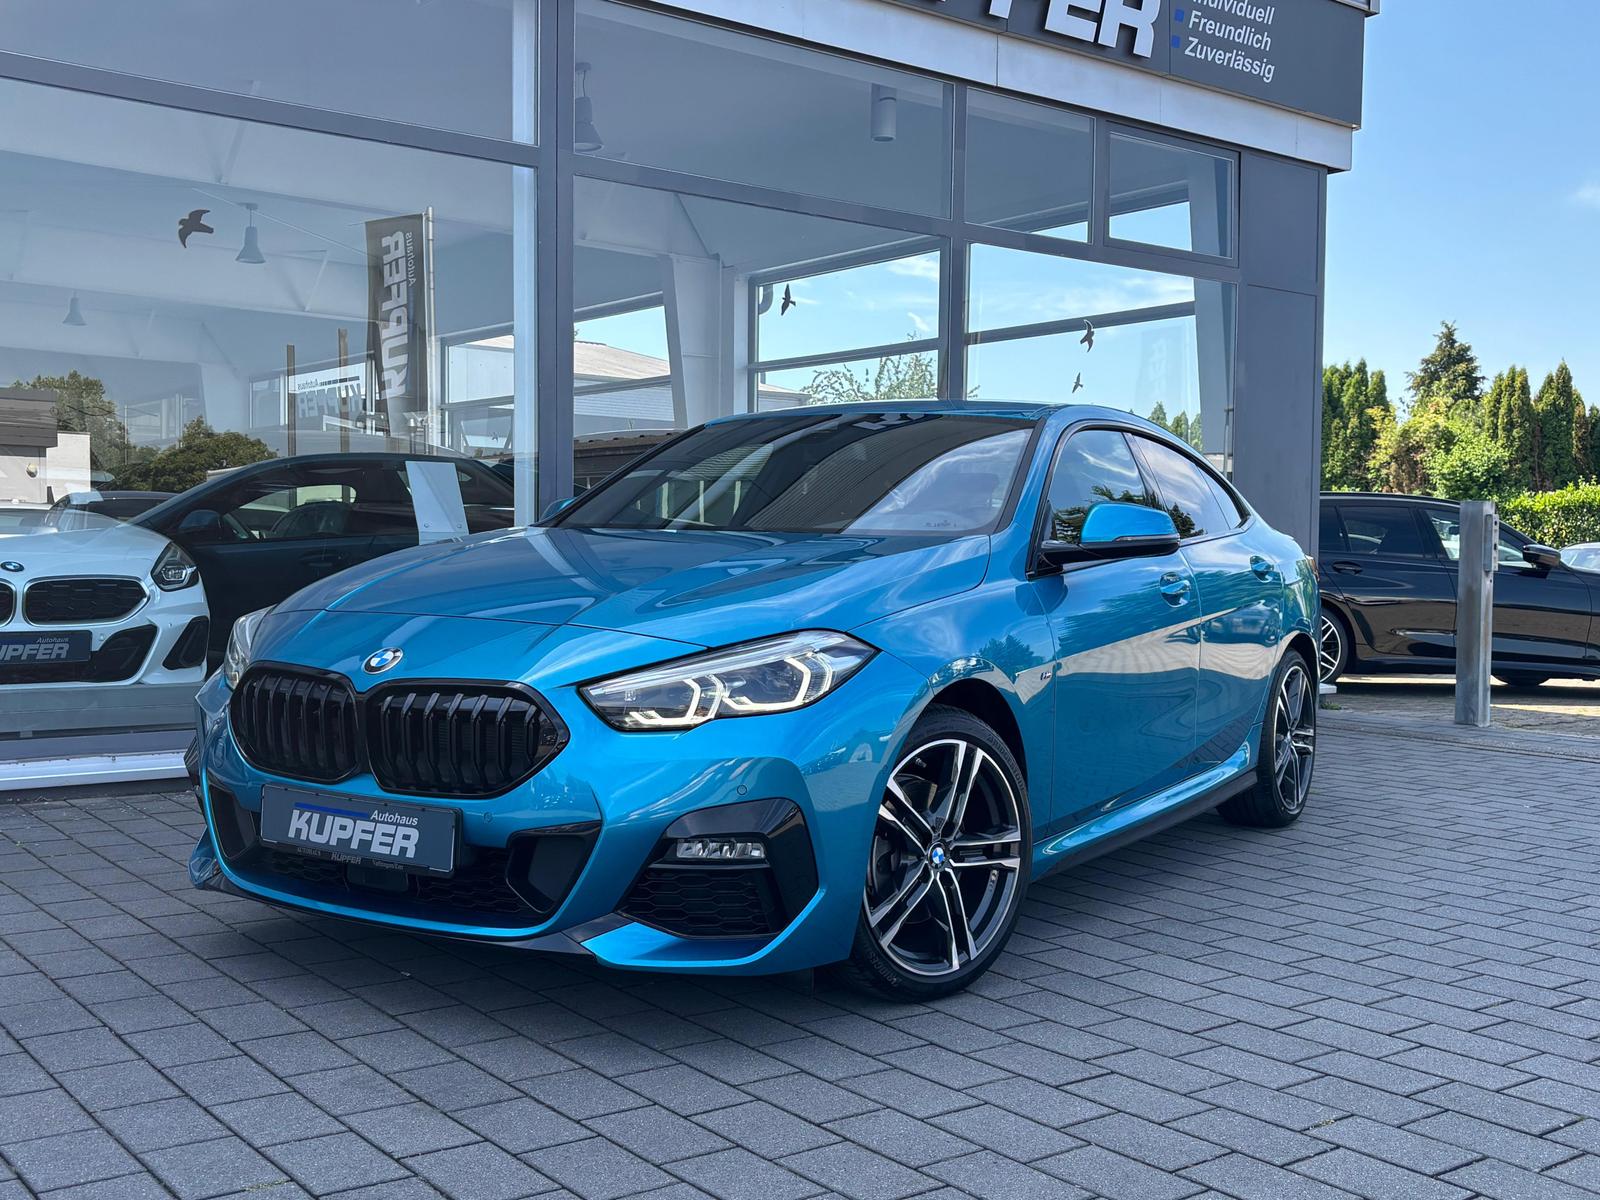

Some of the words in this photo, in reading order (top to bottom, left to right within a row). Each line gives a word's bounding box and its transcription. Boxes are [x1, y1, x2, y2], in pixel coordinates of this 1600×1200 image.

[1192, 0, 1275, 25] dividuell
[1188, 9, 1272, 51] Freundlich
[1184, 36, 1276, 83] Zuverlässig
[288, 809, 420, 859] KUPFER
[370, 809, 419, 826] Autohaus
[331, 851, 362, 864] KUPFER
